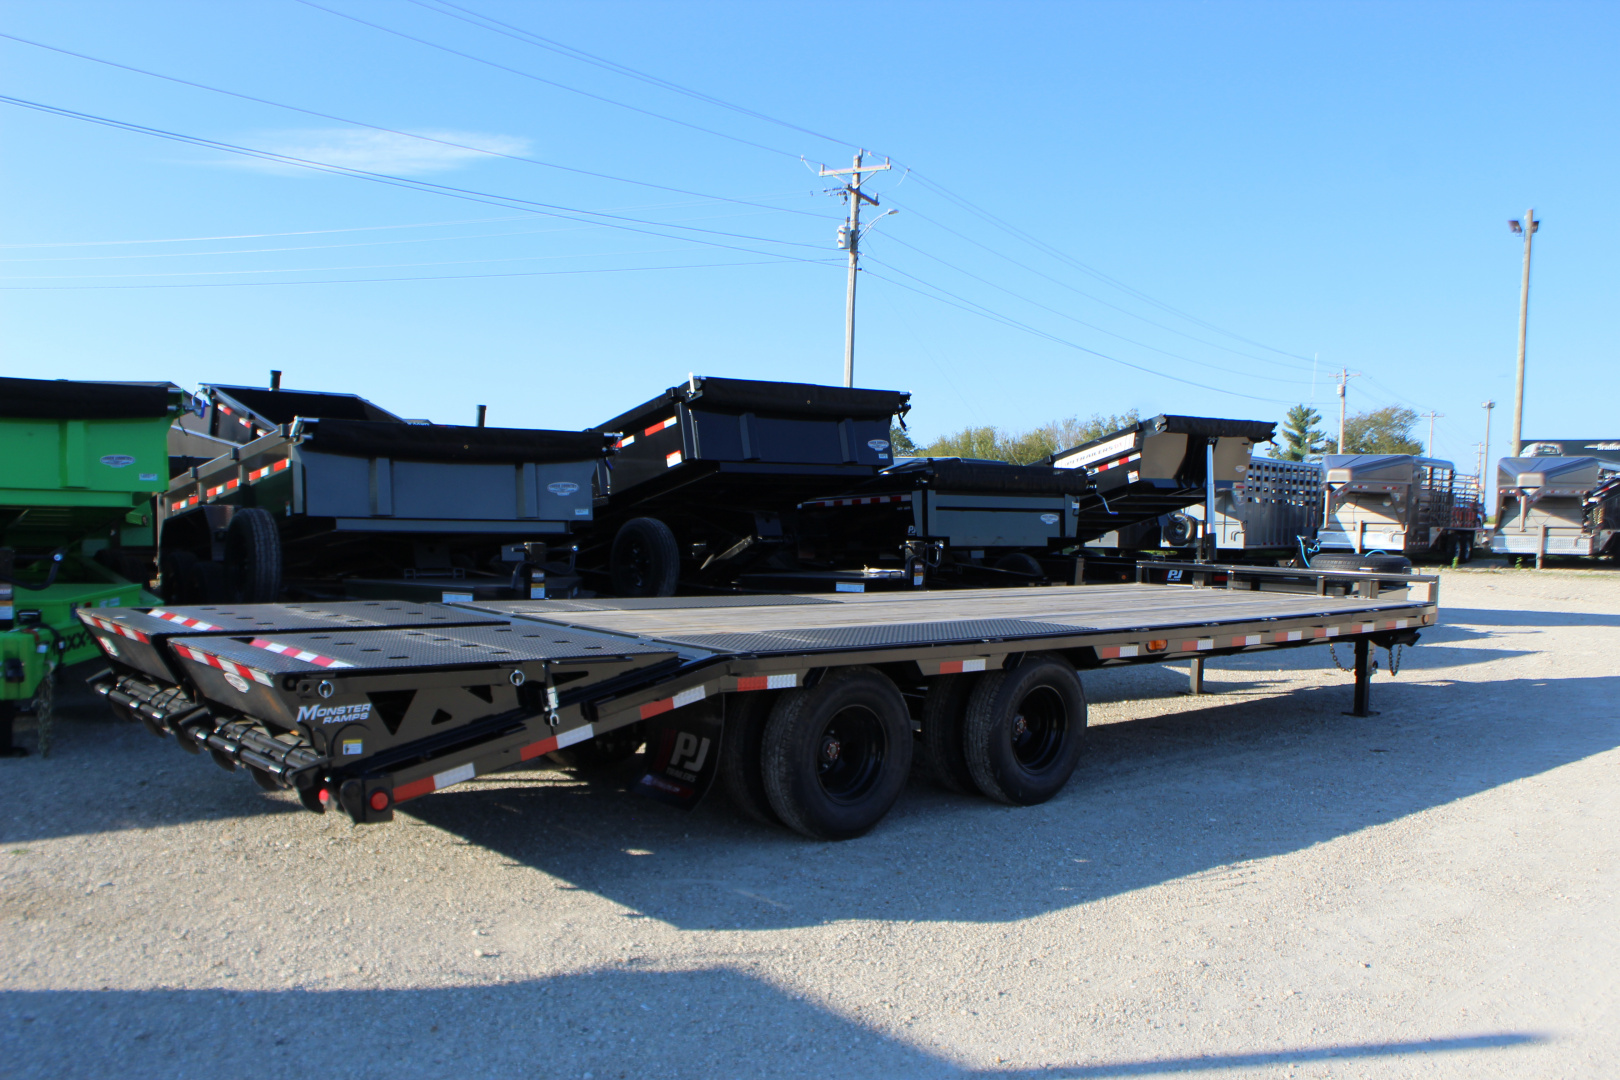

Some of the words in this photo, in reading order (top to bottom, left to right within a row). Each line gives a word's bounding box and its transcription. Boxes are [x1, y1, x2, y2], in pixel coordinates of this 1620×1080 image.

[1167, 570, 1183, 578] PJ
[323, 712, 369, 724] RAMPS
[670, 732, 710, 772] PJ
